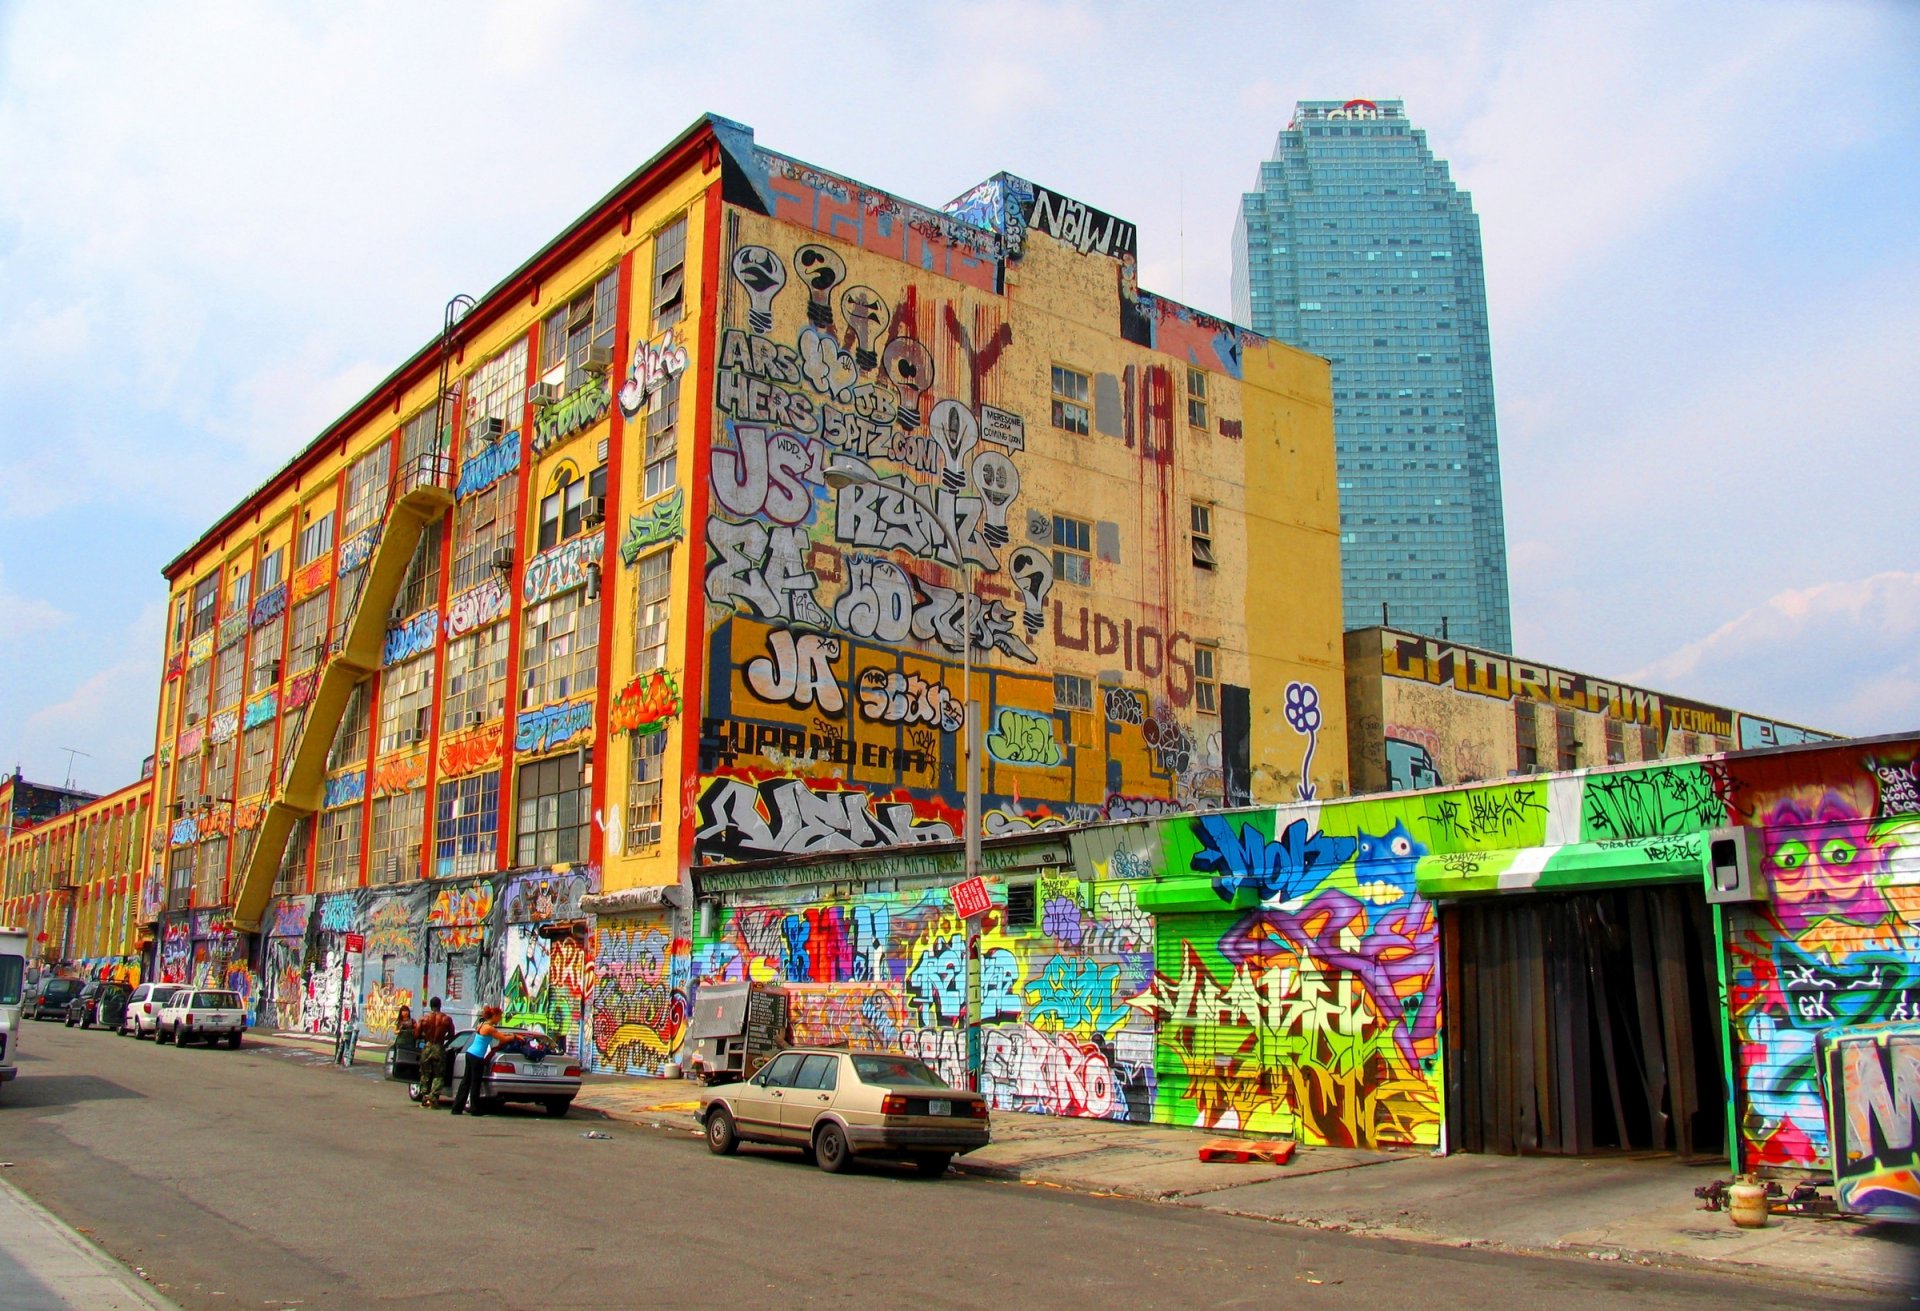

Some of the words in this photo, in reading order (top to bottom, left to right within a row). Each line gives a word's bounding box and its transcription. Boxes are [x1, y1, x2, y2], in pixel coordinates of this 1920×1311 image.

[1328, 104, 1376, 120] citi
[719, 328, 802, 384] ARS
[716, 371, 819, 434] HERS
[747, 629, 844, 712] JA
[702, 874, 745, 890] ANTHRAX!
[749, 871, 792, 887] ANTHRAX!
[795, 866, 840, 882] ANTHRAX!
[844, 859, 900, 880] ANTHRAX!
[904, 854, 962, 874] ANTHRAX!
[1798, 990, 1834, 1020] GK
